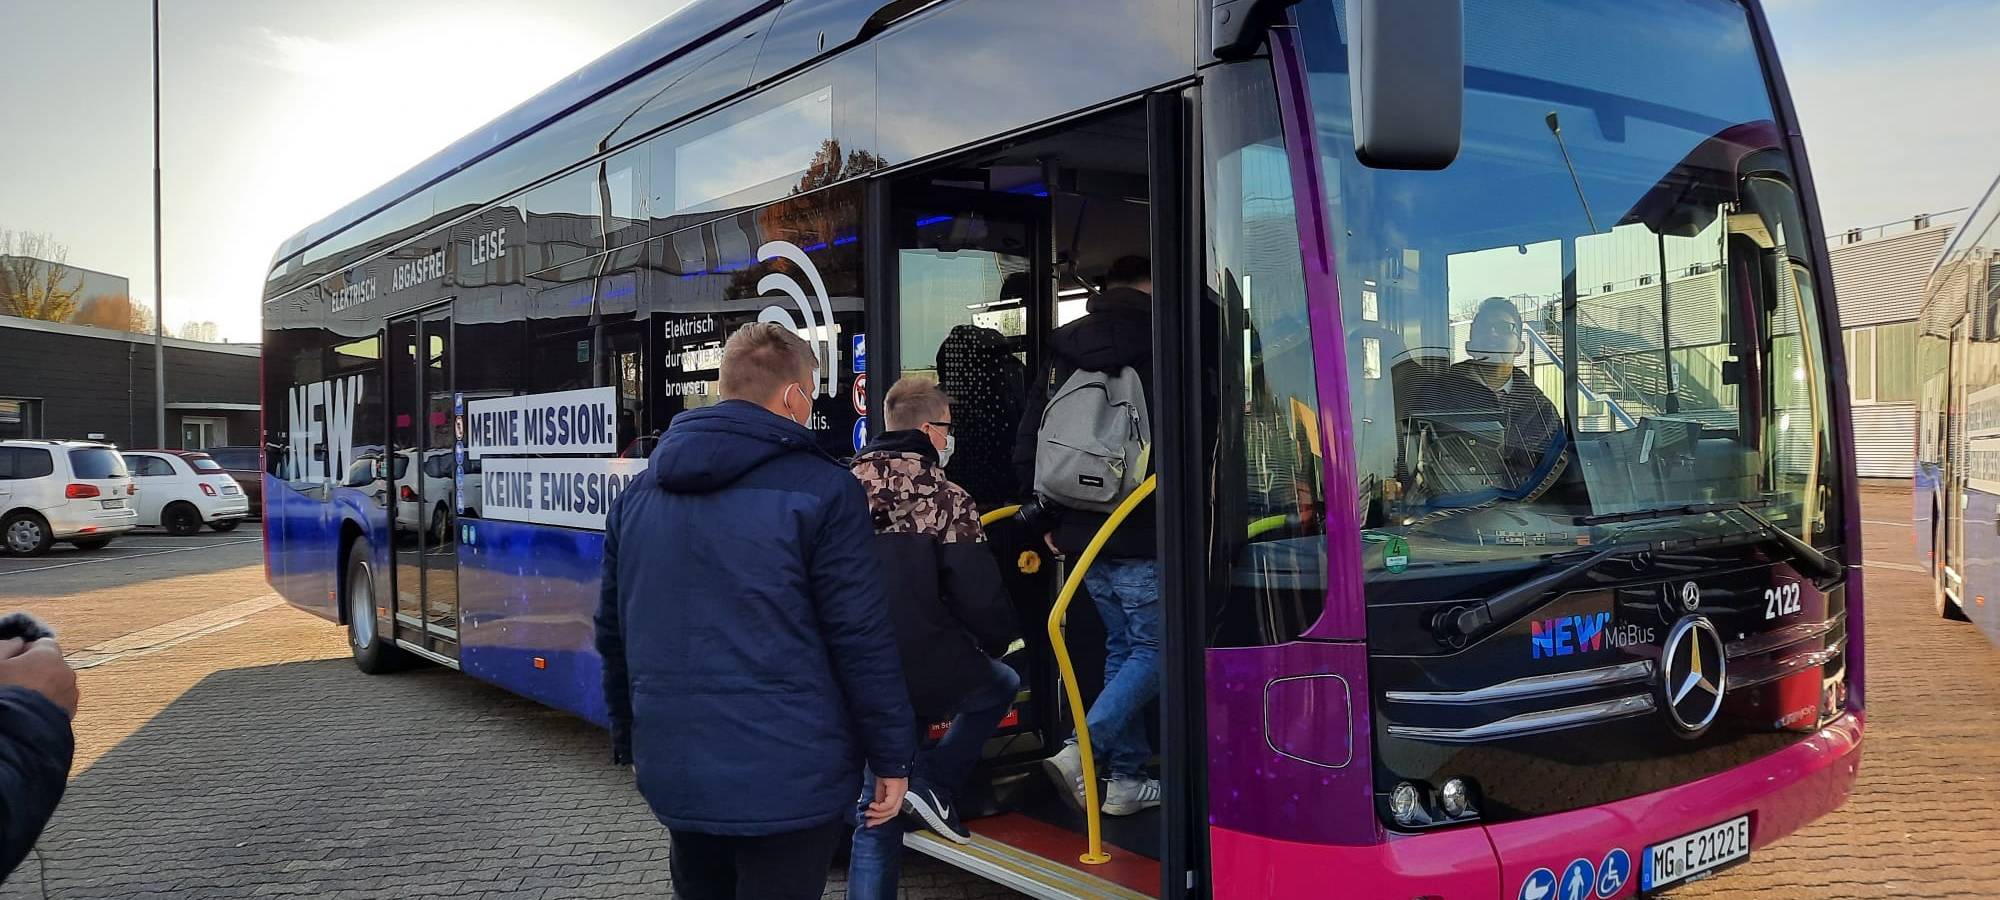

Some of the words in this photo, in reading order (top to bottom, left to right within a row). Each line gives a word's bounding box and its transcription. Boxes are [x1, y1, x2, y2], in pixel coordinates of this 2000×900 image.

[331, 277, 376, 312] ELEKTRISCH
[391, 250, 445, 293] ABGASFREI
[471, 228, 506, 265] LEISE
[665, 313, 713, 338] Elektrisch
[665, 379, 707, 396] browsen
[471, 410, 518, 447] MEINE
[524, 403, 613, 445] MISSION:
[485, 471, 533, 509] KEINE
[1393, 538, 1400, 556] 4
[1764, 582, 1800, 620] 2122
[1605, 624, 1655, 649] MöBus
[1654, 846, 1675, 882] MG
[1686, 839, 1695, 871] E
[1698, 826, 1735, 867] 2122
[1738, 821, 1747, 852] E
